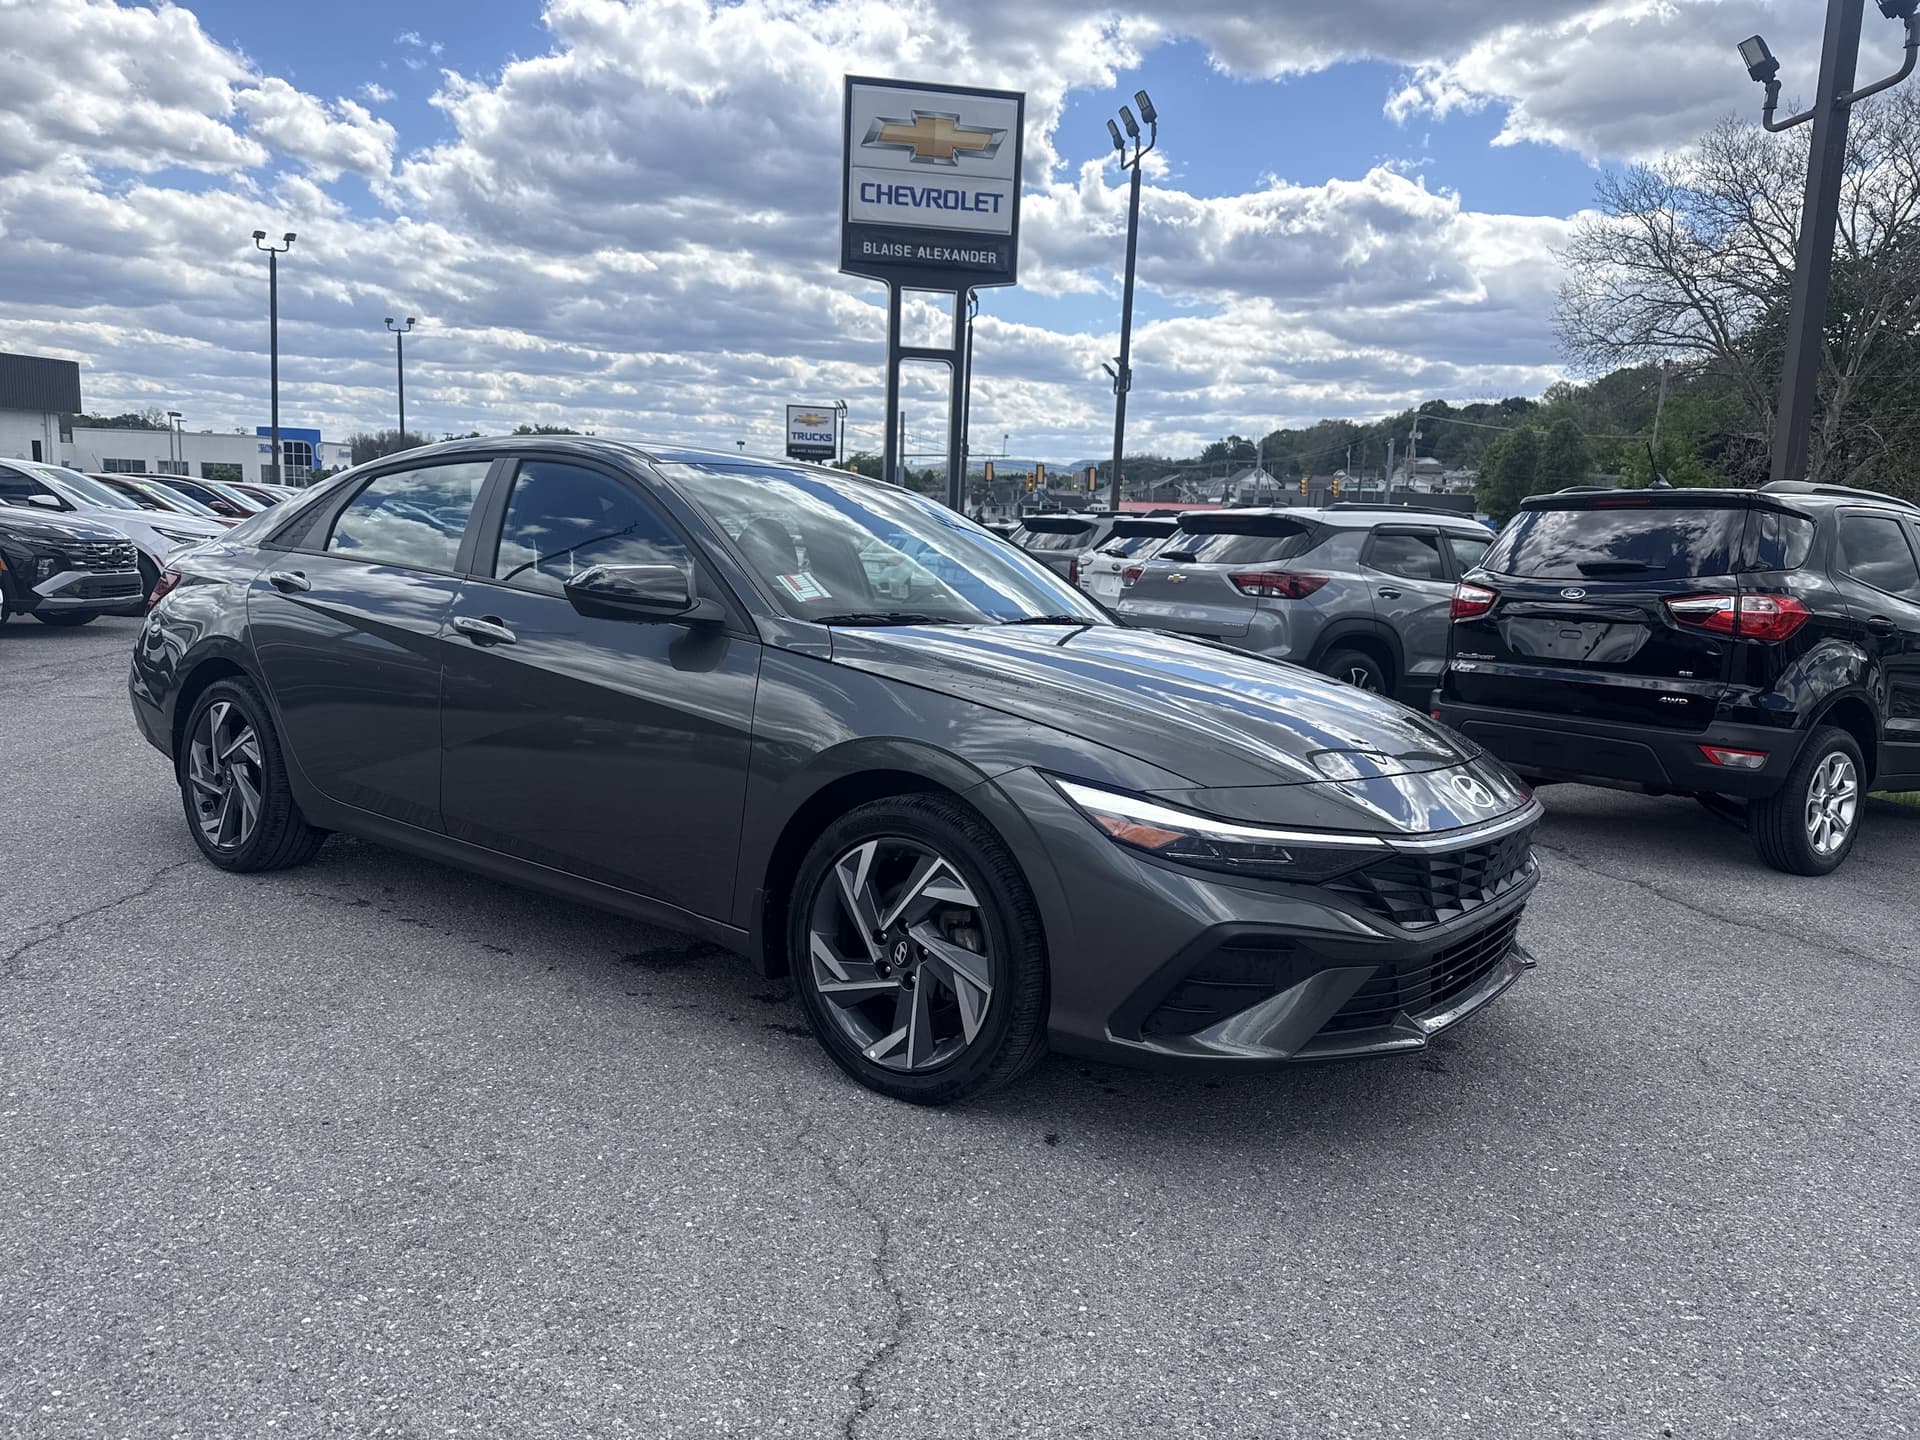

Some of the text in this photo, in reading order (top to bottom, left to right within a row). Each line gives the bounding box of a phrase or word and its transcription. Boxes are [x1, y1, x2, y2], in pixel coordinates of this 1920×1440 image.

[860, 182, 1004, 213] CHEVROLET
[863, 241, 997, 264] BLAISE ALEXANDER
[791, 431, 833, 442] TRUCKS
